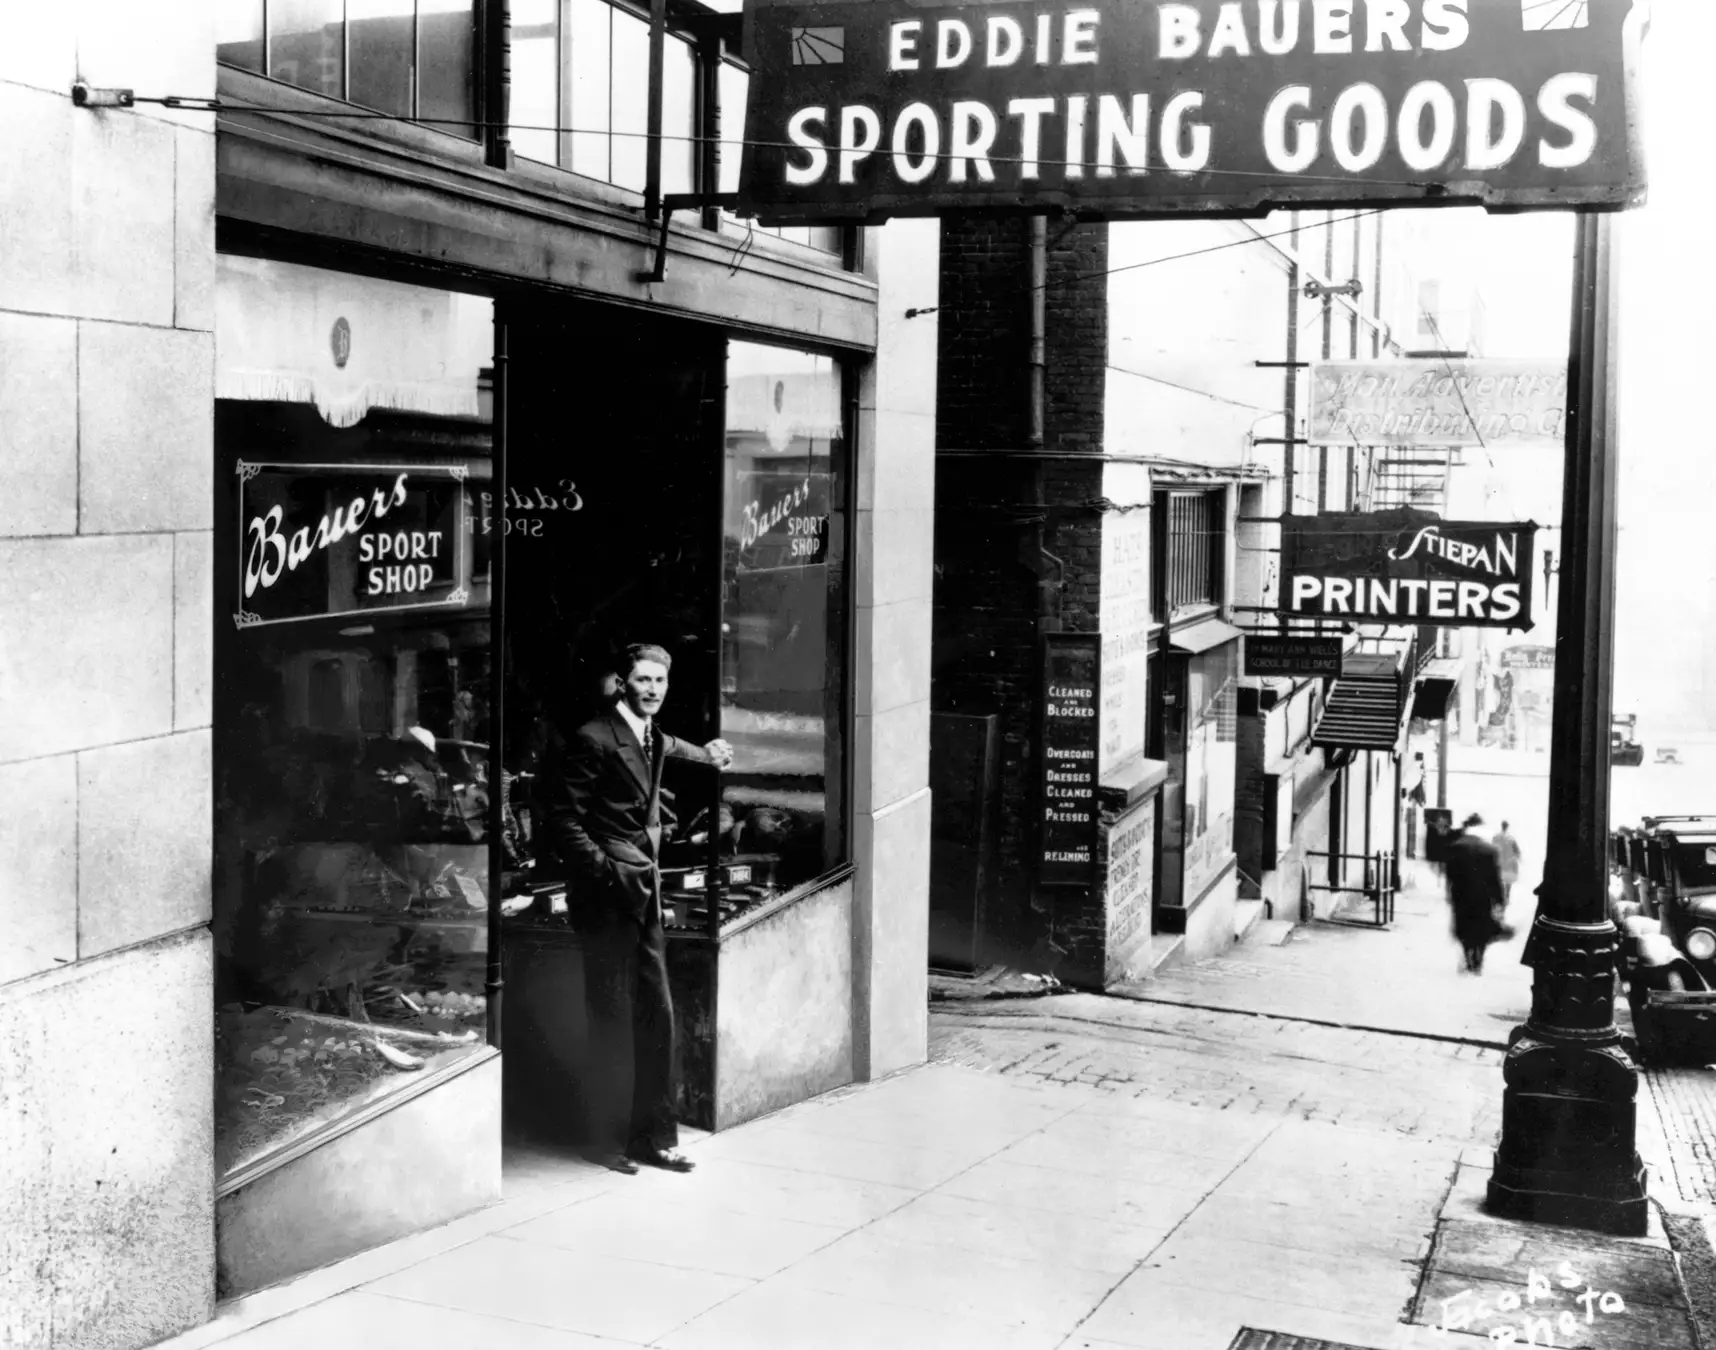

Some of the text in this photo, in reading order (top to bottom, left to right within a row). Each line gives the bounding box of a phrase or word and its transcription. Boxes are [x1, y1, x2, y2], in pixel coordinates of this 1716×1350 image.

[888, 0, 1470, 72] EDDIE BAUERS
[785, 71, 1599, 185] SPORTING GOODS
[741, 478, 809, 552] Bauers
[787, 516, 825, 536] SPORT
[245, 472, 409, 598] Bauers
[359, 531, 442, 562] SPORT
[791, 537, 820, 556] SHOP
[368, 564, 433, 595] SHOP
[1292, 575, 1521, 620] PRINTERS
[1048, 685, 1093, 698] CLEANED
[1047, 703, 1095, 717] BLOCKED
[1047, 769, 1091, 782] DRESSES
[1046, 785, 1093, 798] CLEANED
[1045, 808, 1090, 822] PRESSED
